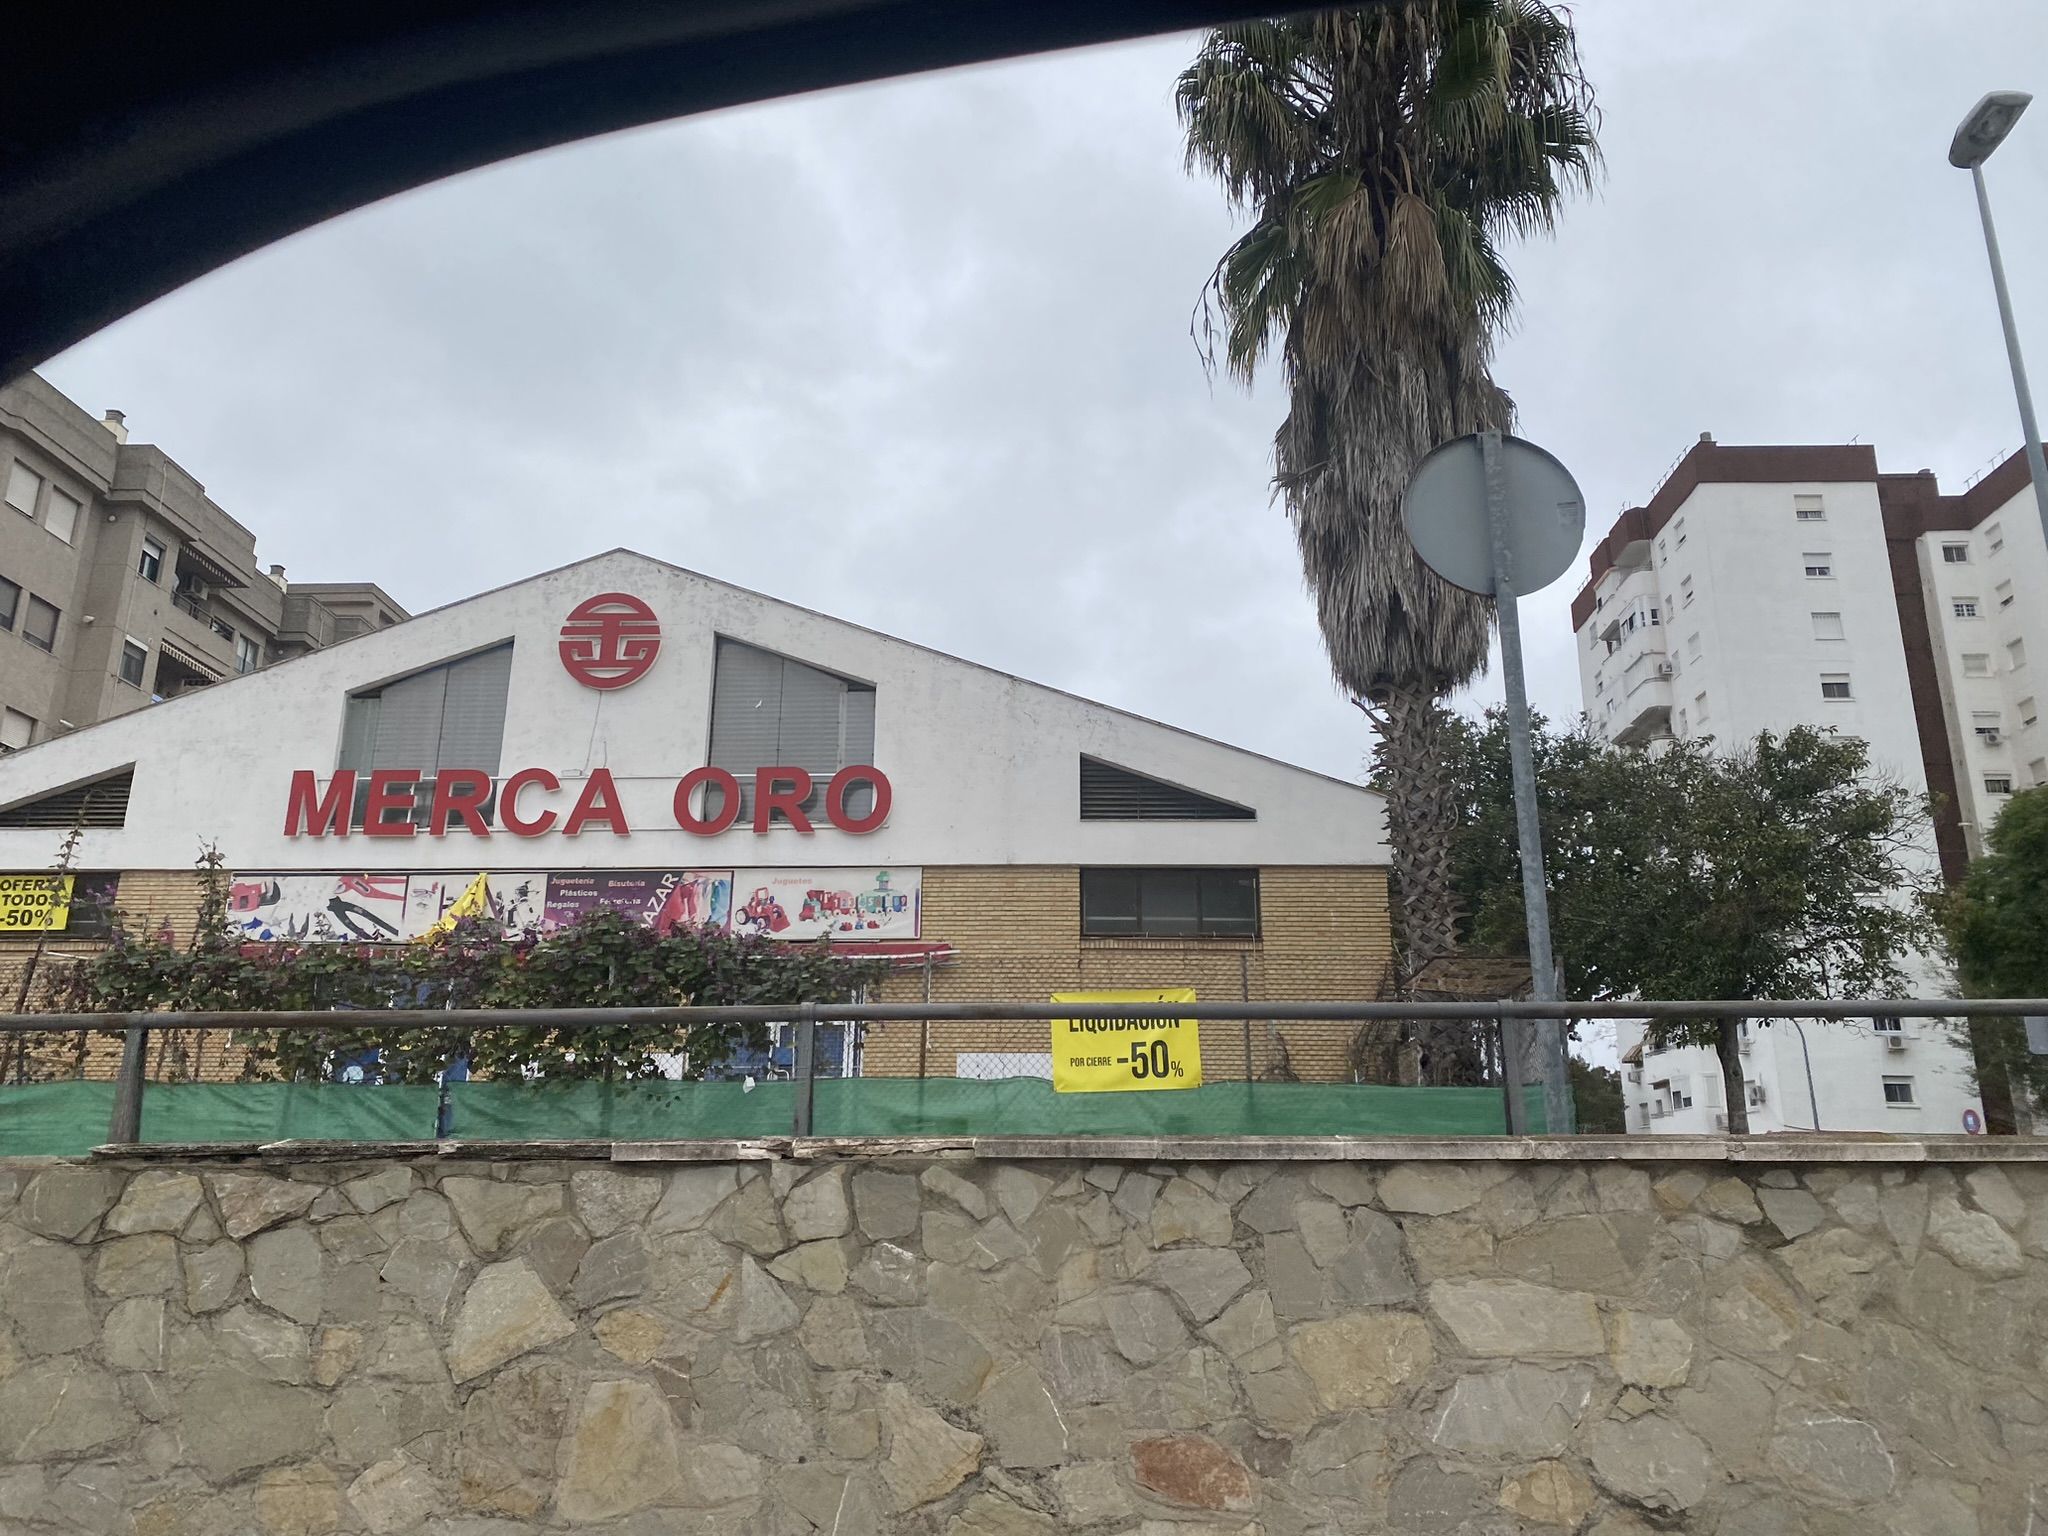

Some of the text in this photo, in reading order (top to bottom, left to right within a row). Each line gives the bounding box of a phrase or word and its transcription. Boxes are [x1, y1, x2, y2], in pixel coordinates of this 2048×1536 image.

[283, 765, 894, 838] MERCA ORO
[772, 877, 813, 886] Juguetes
[0, 909, 54, 927] -50%
[1070, 1040, 1184, 1079] POR CIERRE -50%
